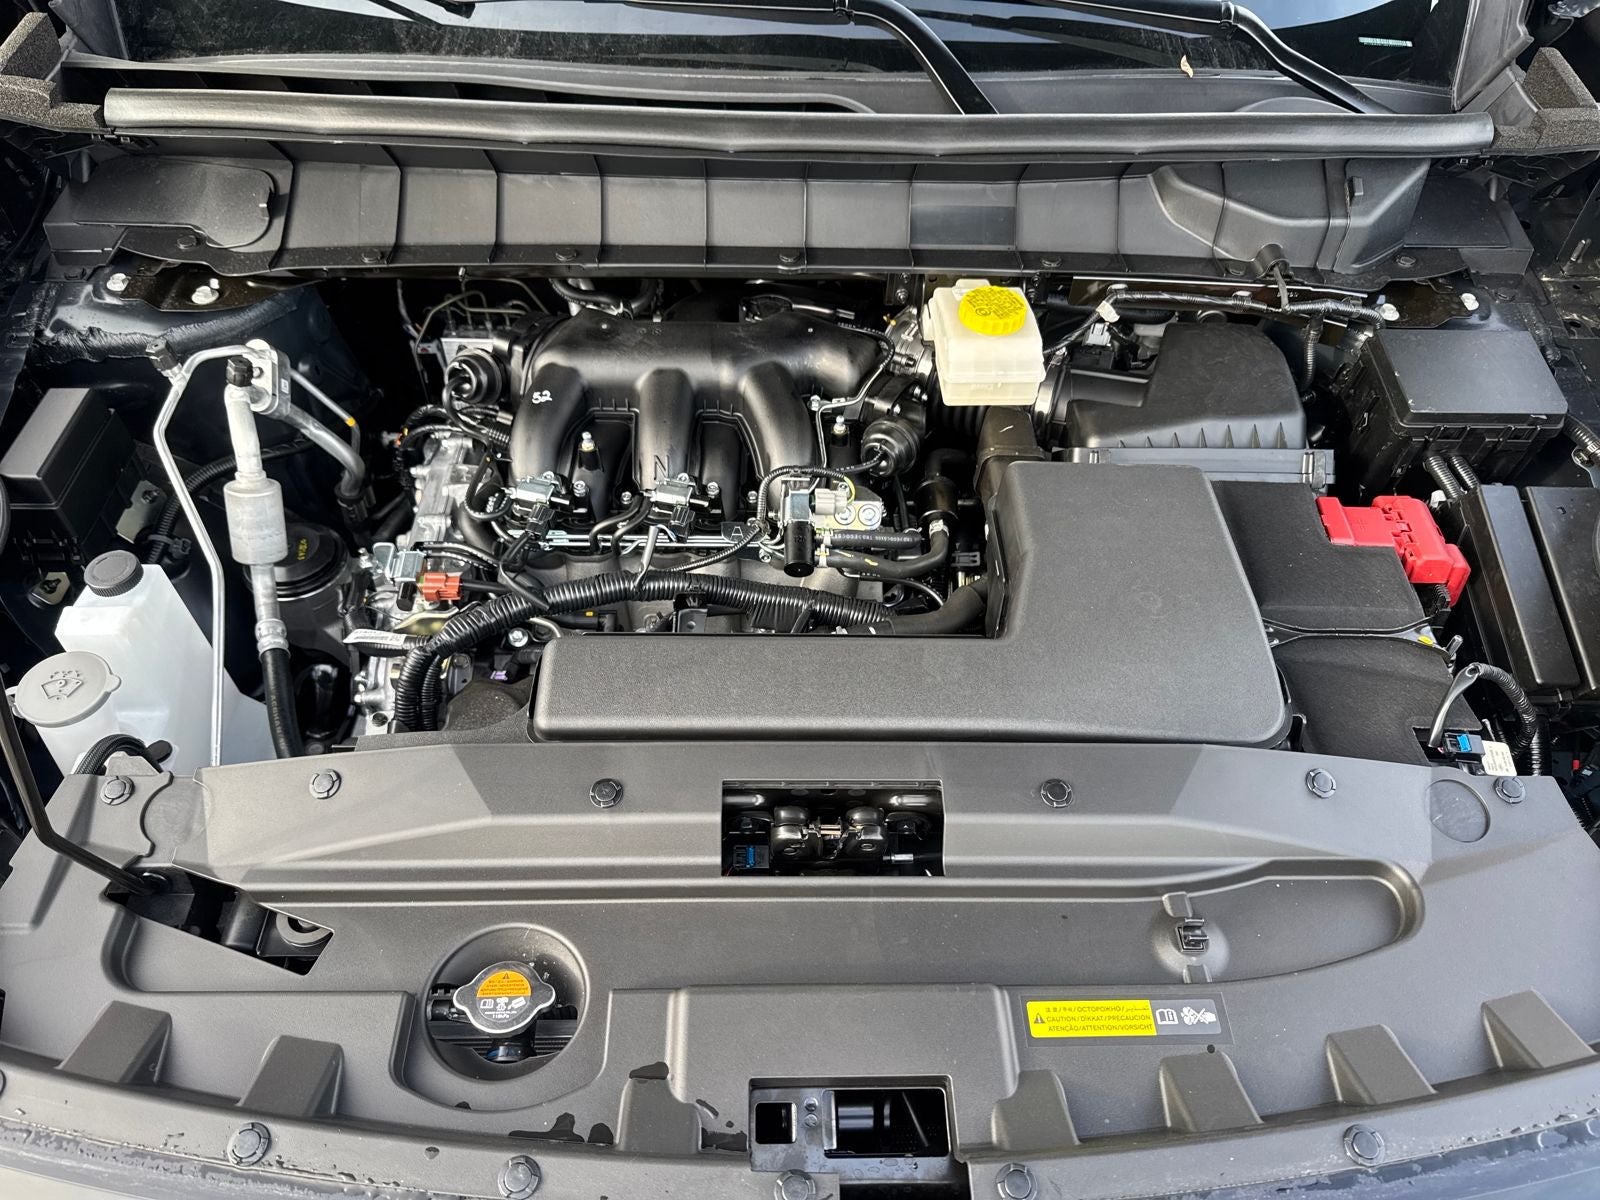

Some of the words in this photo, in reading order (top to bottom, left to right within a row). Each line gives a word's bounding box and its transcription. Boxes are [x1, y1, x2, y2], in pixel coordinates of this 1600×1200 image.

[532, 389, 552, 404] 52
[654, 454, 670, 480] N
[730, 526, 744, 540] A
